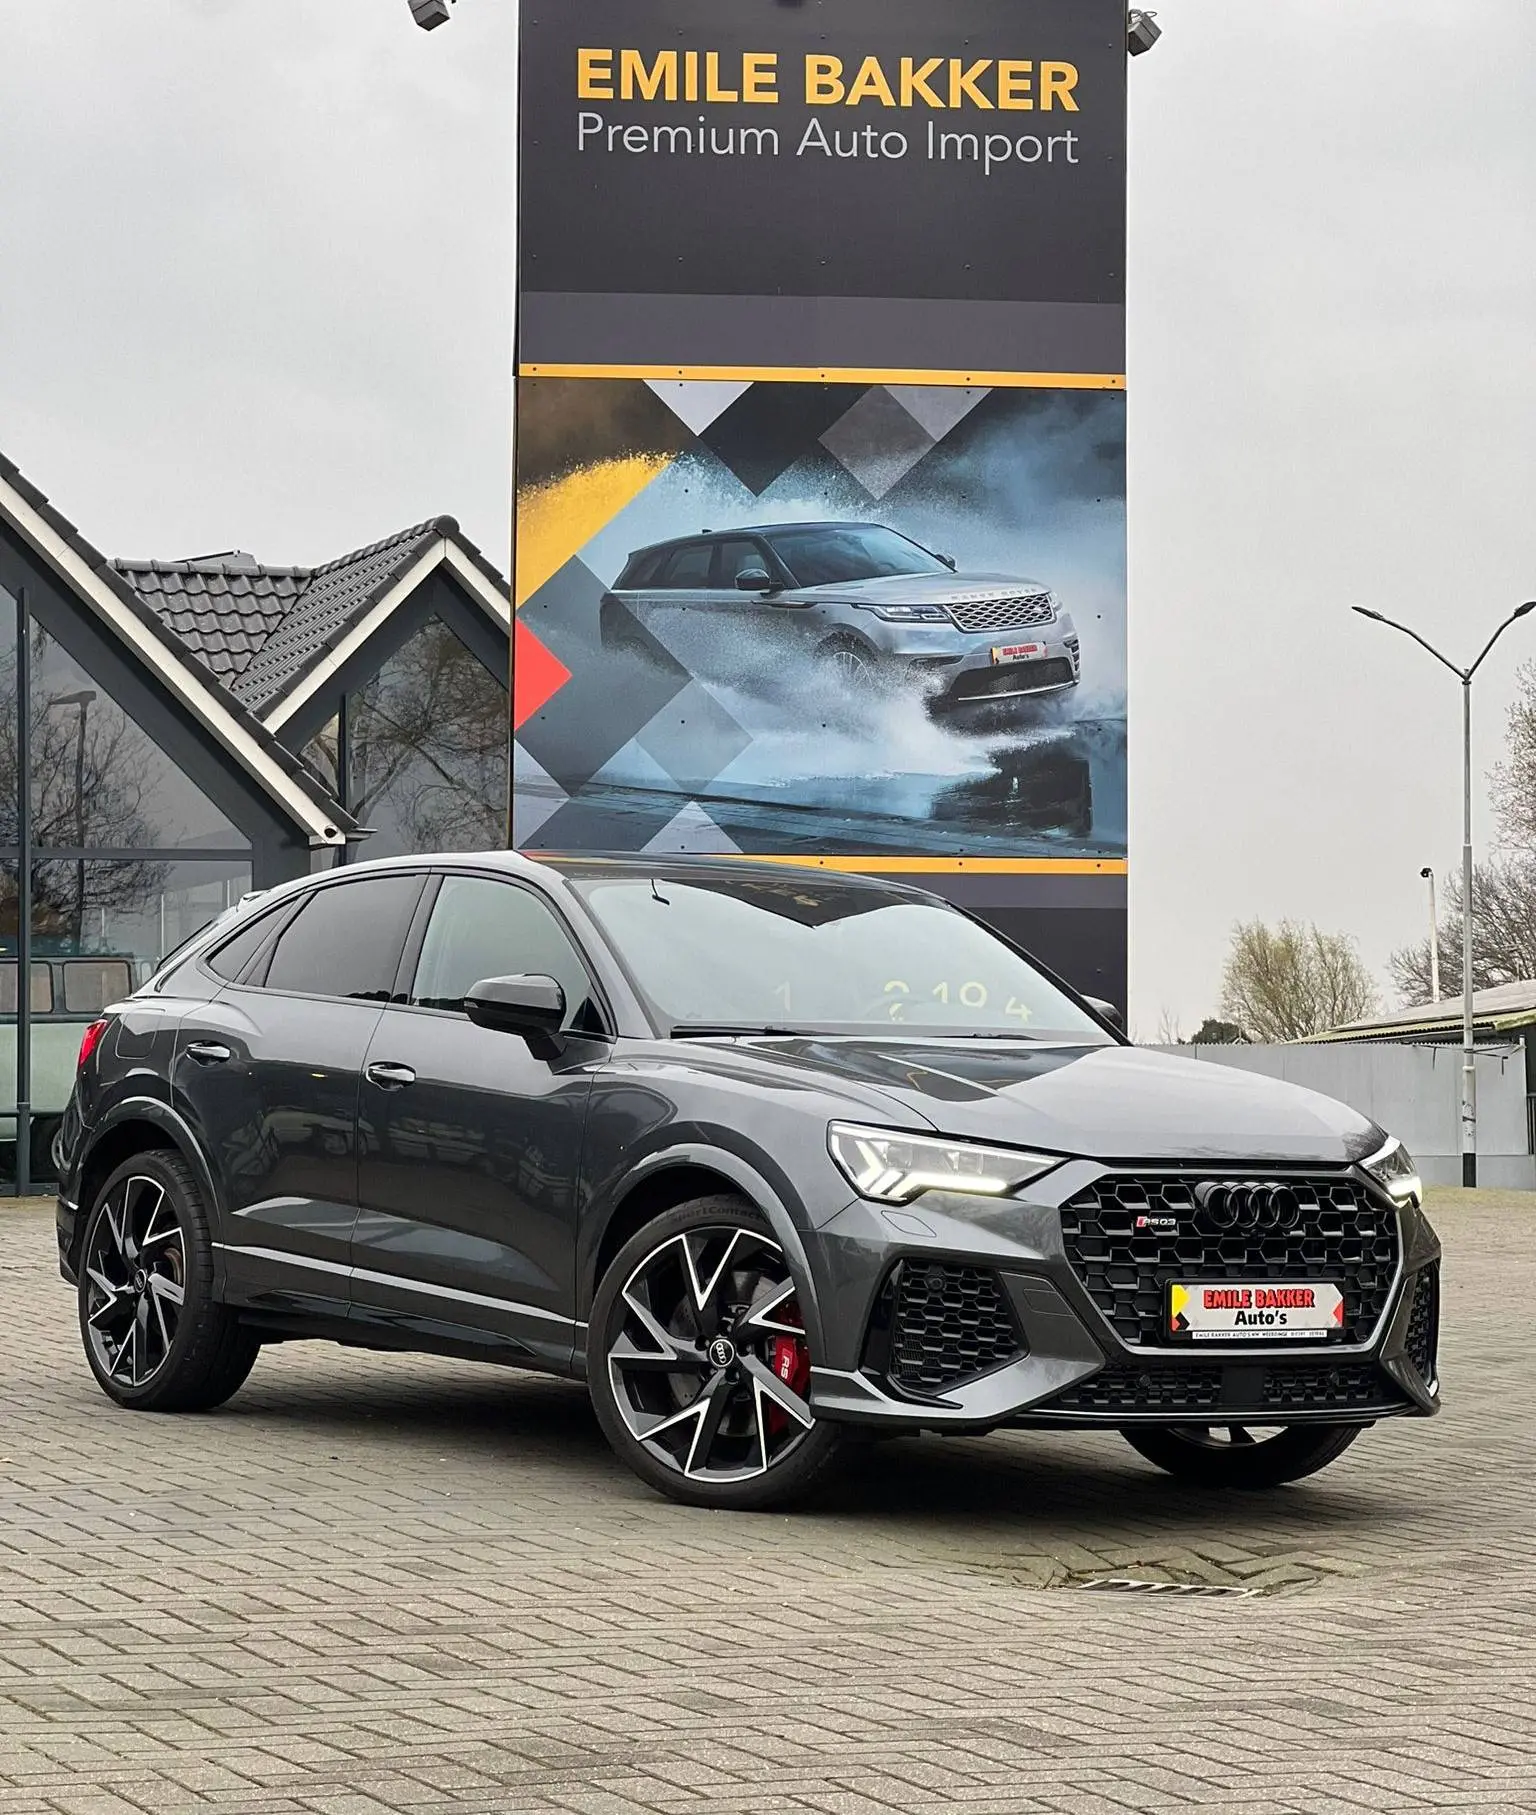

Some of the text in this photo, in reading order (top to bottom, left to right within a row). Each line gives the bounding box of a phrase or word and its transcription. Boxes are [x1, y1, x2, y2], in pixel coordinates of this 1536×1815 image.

[577, 48, 1080, 112] EMILE BAKKER
[577, 112, 1080, 175] Premium Auto Import
[1203, 1289, 1315, 1309] EMILE BAKKER
[1234, 1311, 1288, 1325] Auto's
[781, 1355, 790, 1379] RS
